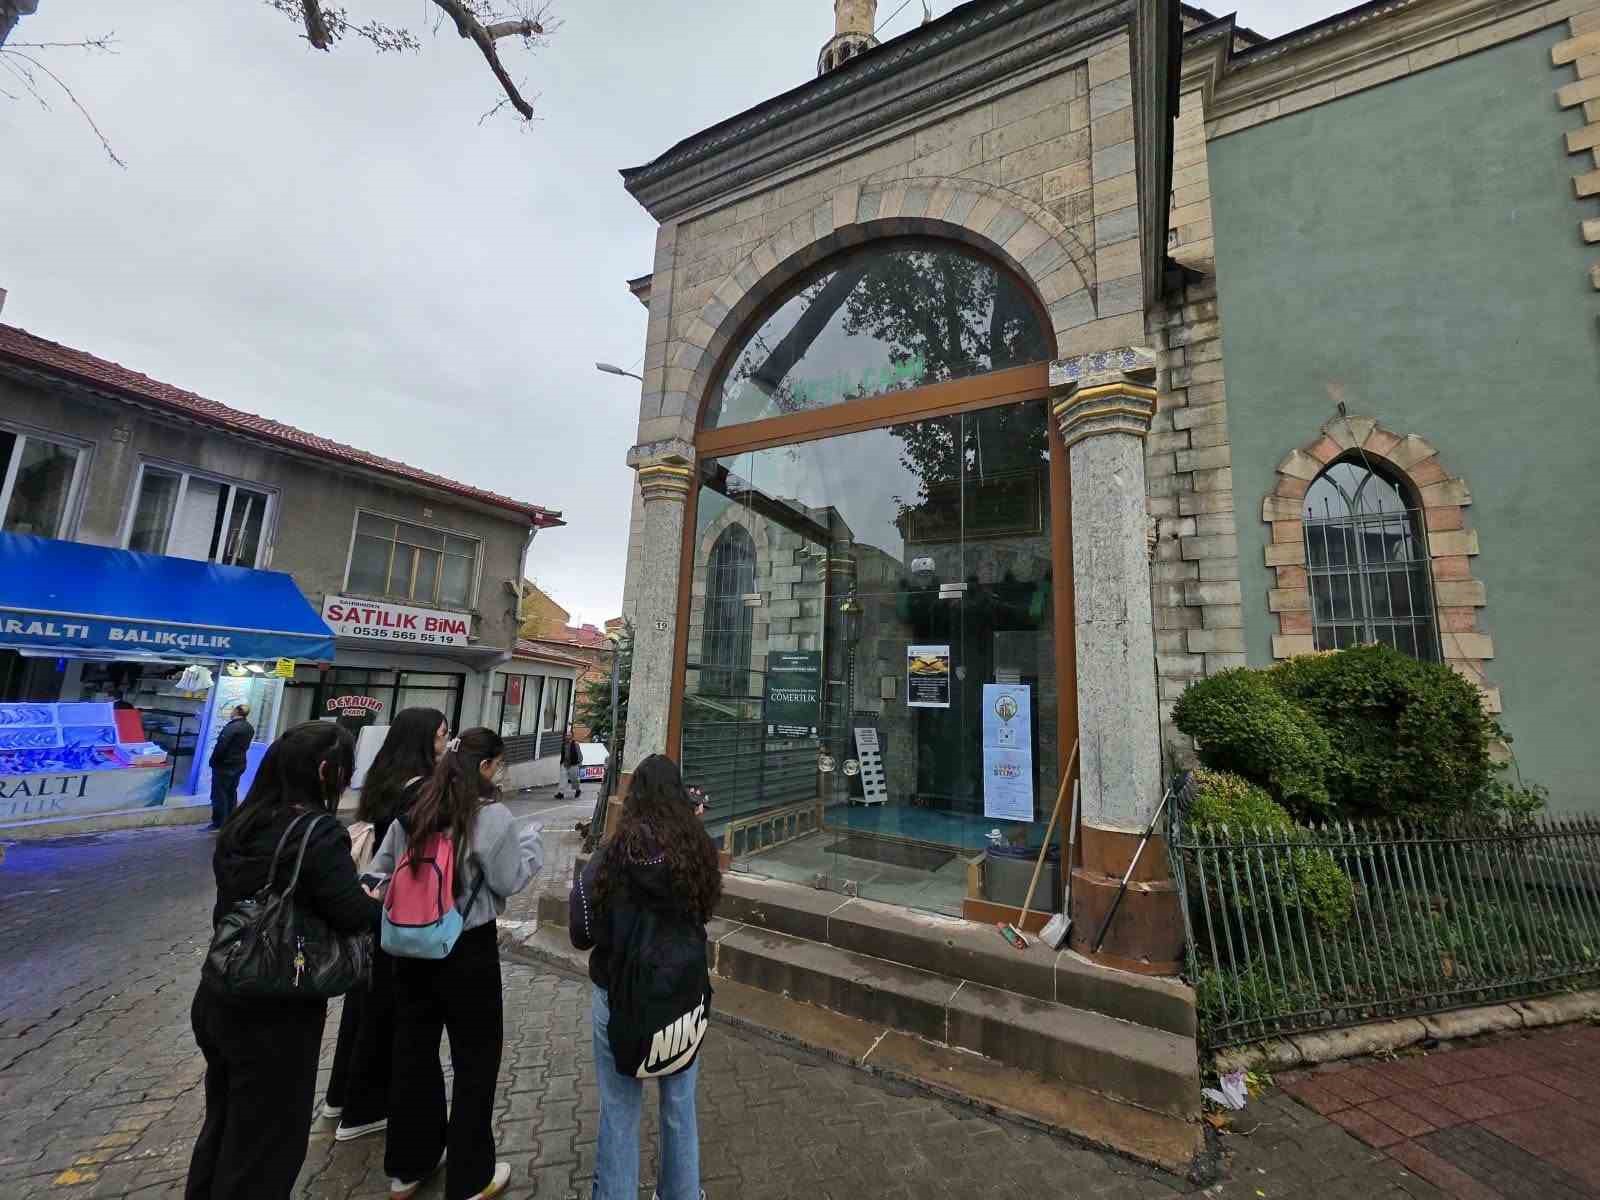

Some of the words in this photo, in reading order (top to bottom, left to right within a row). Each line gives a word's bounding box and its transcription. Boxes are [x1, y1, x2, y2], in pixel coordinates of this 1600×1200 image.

[0, 617, 88, 639] RALTI
[328, 605, 418, 629] SATILIK
[425, 616, 467, 635] BİNA
[353, 626, 388, 637] 0535
[391, 630, 416, 641] 565
[420, 633, 435, 642] 55
[440, 635, 454, 643] 19
